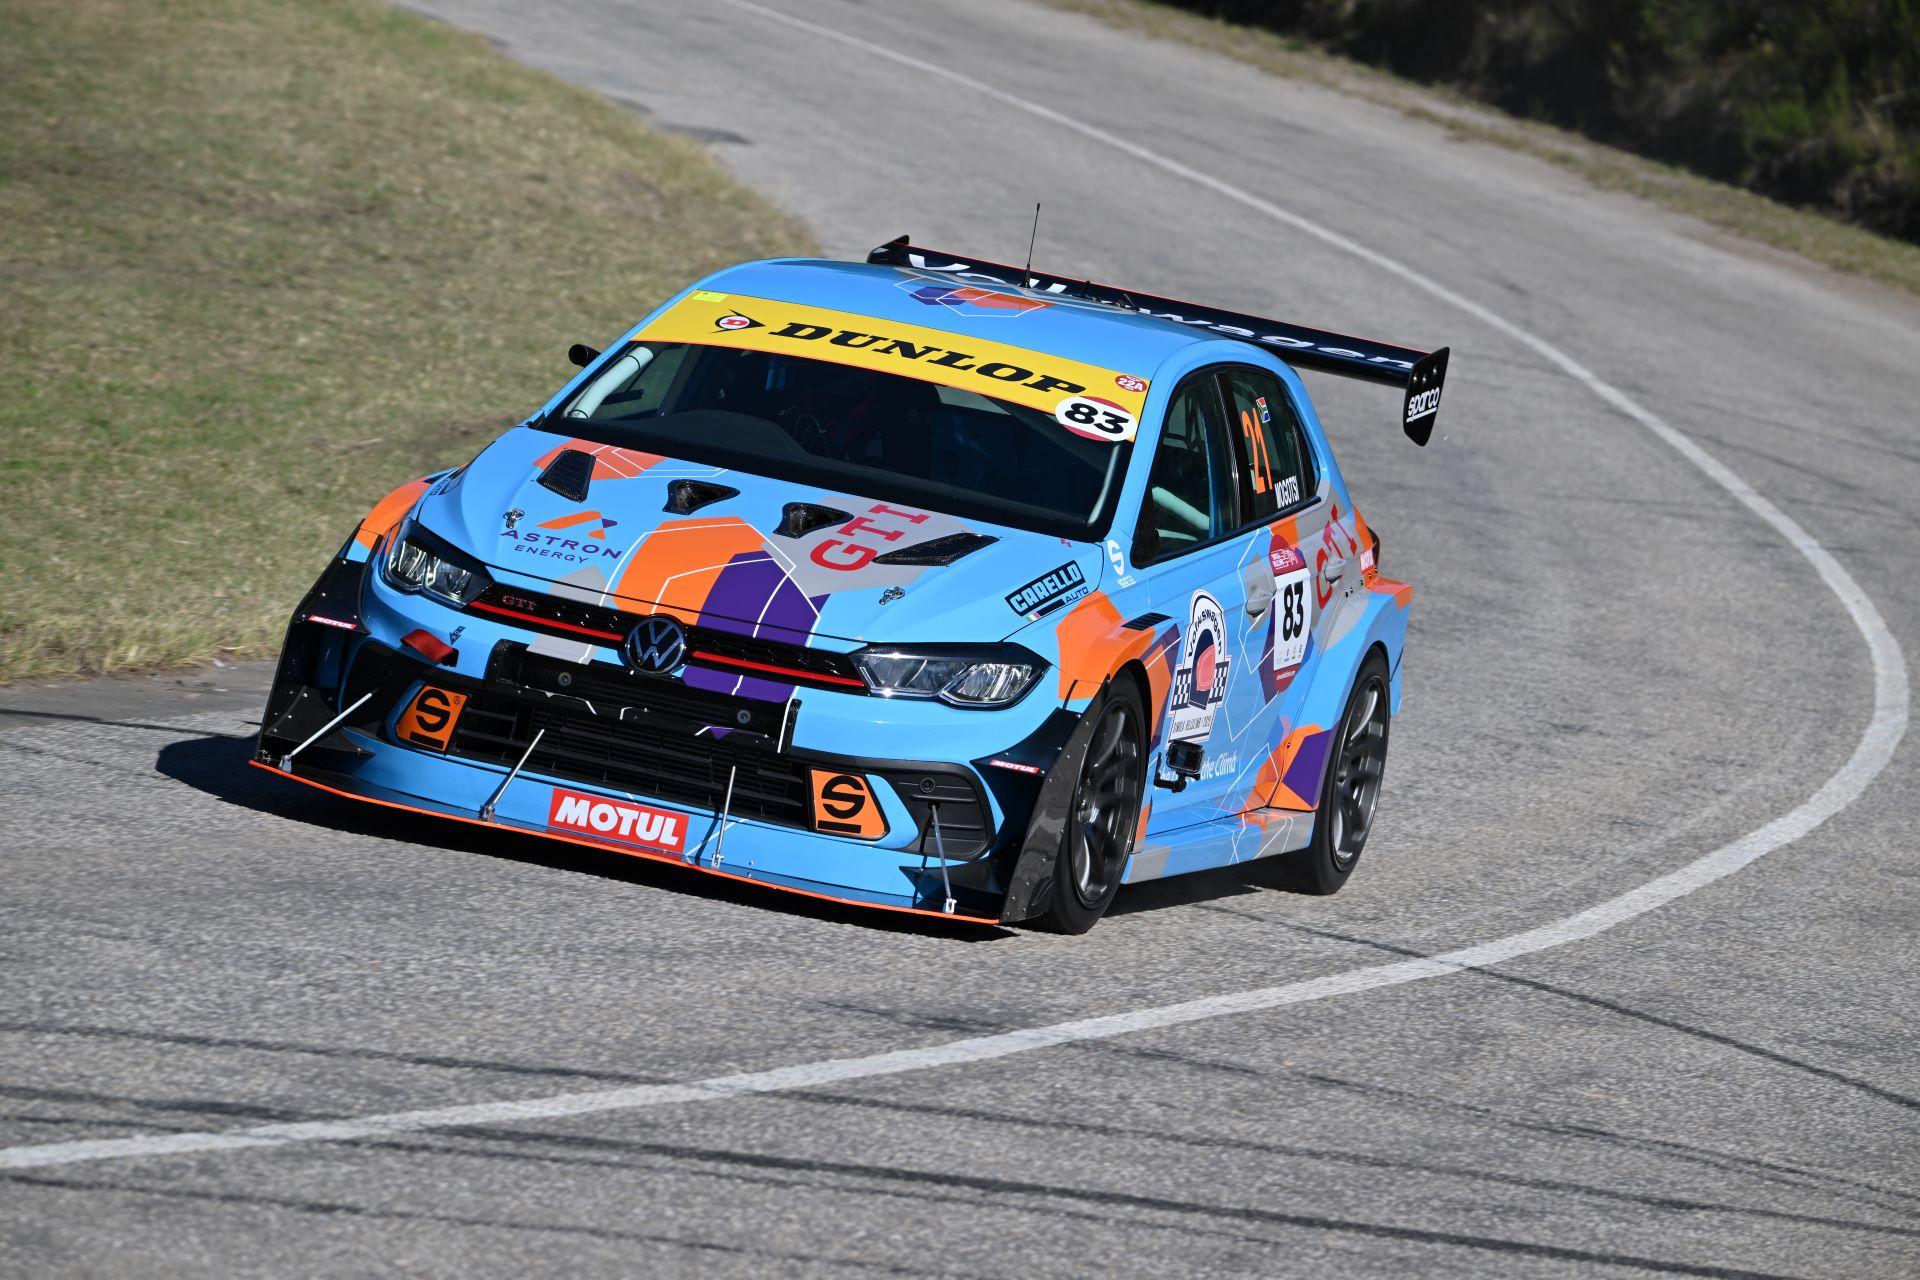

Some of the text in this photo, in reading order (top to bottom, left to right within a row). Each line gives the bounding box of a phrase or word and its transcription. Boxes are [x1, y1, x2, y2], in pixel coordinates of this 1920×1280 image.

[767, 321, 1087, 395] DUNLOP
[1118, 377, 1144, 392] 22A
[1064, 402, 1130, 434] 83
[1407, 386, 1441, 418] sparco
[1241, 408, 1273, 494] 21
[499, 529, 623, 560] ASTRON
[809, 503, 931, 572] GTI
[514, 544, 590, 564] ENERGY
[502, 594, 536, 611] GTI
[1009, 562, 1083, 612] CARELLO
[1064, 586, 1089, 604] AUTO
[1282, 580, 1304, 642] 83
[993, 760, 1036, 773] MOTUL
[1214, 749, 1238, 777] Climb
[554, 795, 680, 846] MOTUL
